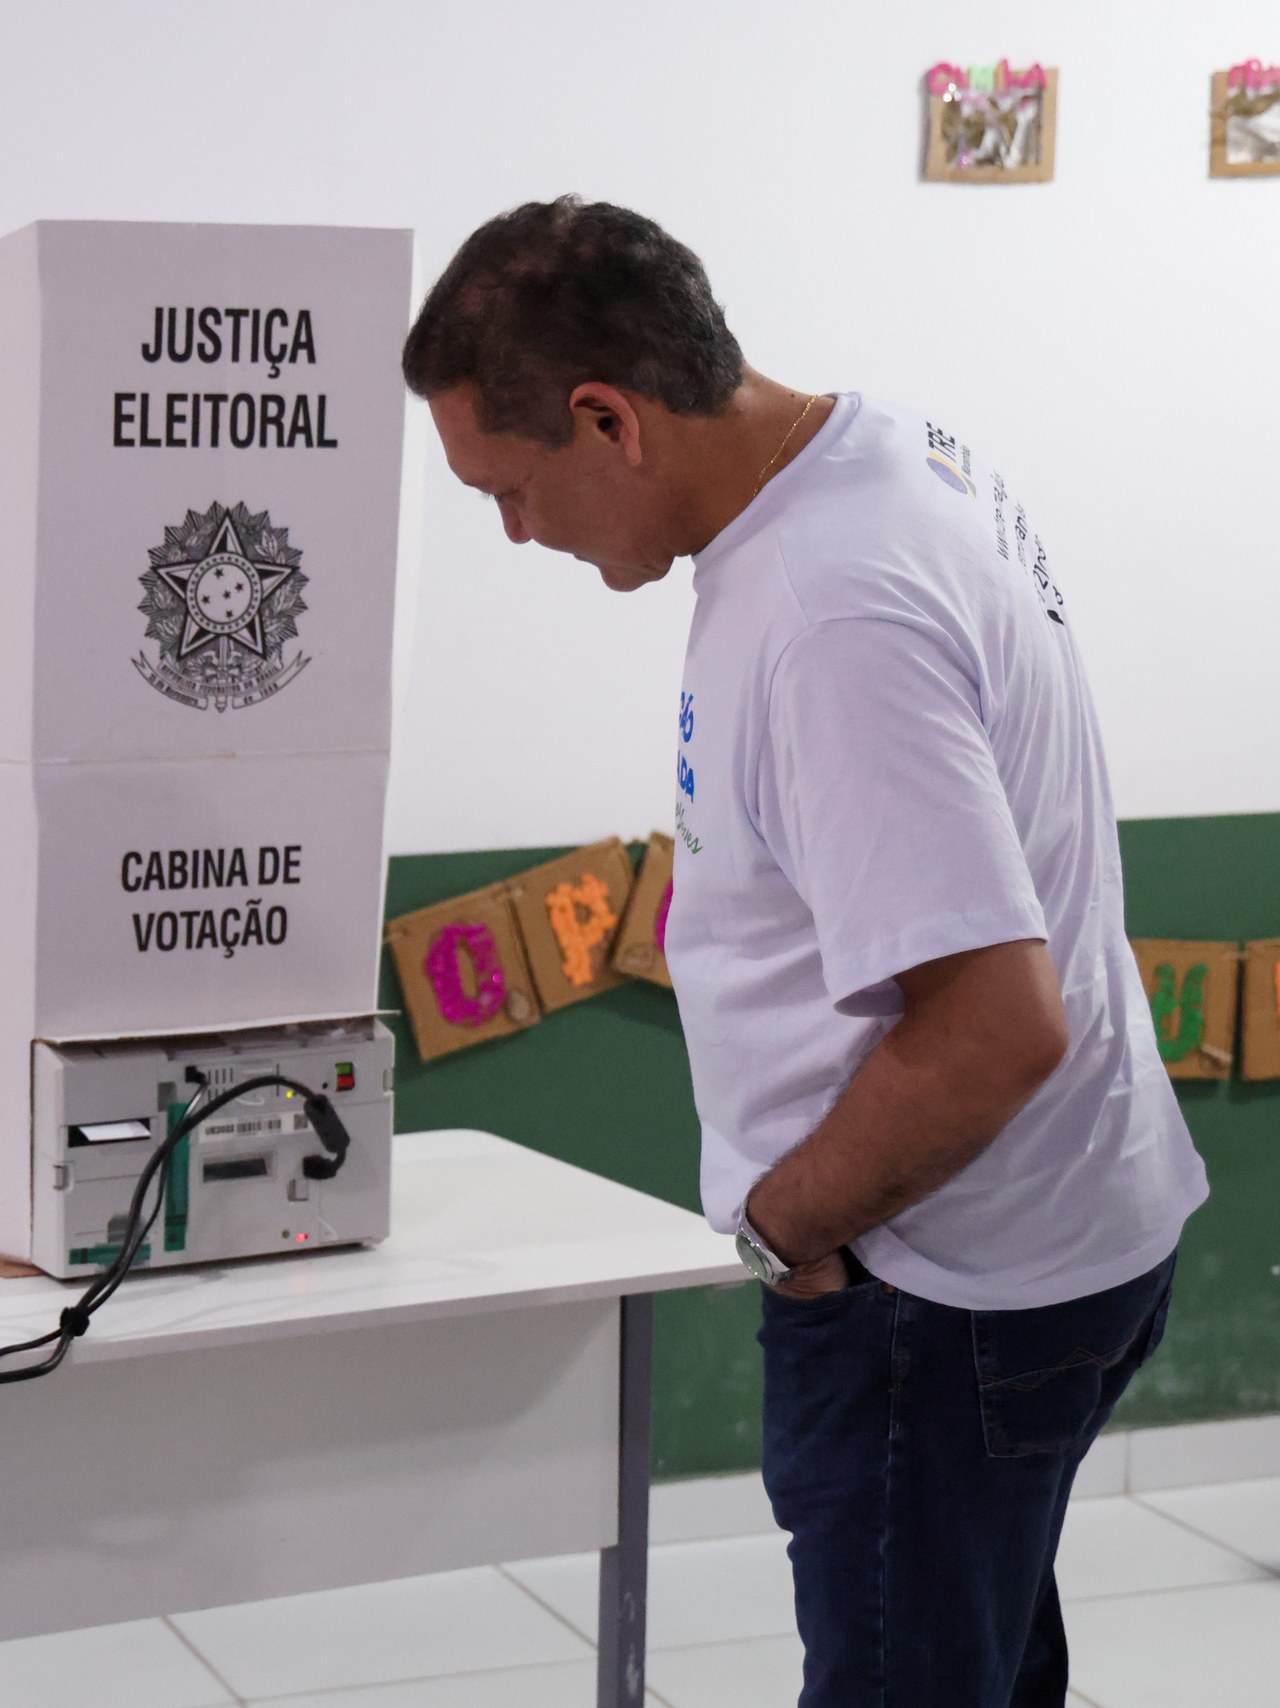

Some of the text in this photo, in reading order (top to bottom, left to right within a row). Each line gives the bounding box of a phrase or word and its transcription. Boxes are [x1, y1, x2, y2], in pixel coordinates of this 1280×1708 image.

[141, 306, 317, 380] JUSTIÇA
[113, 392, 338, 449] ELEITORAL
[926, 421, 956, 463] TRE
[121, 844, 302, 893] CABINA DE
[131, 898, 288, 959] VOTAÇÃO
[546, 873, 617, 985] P
